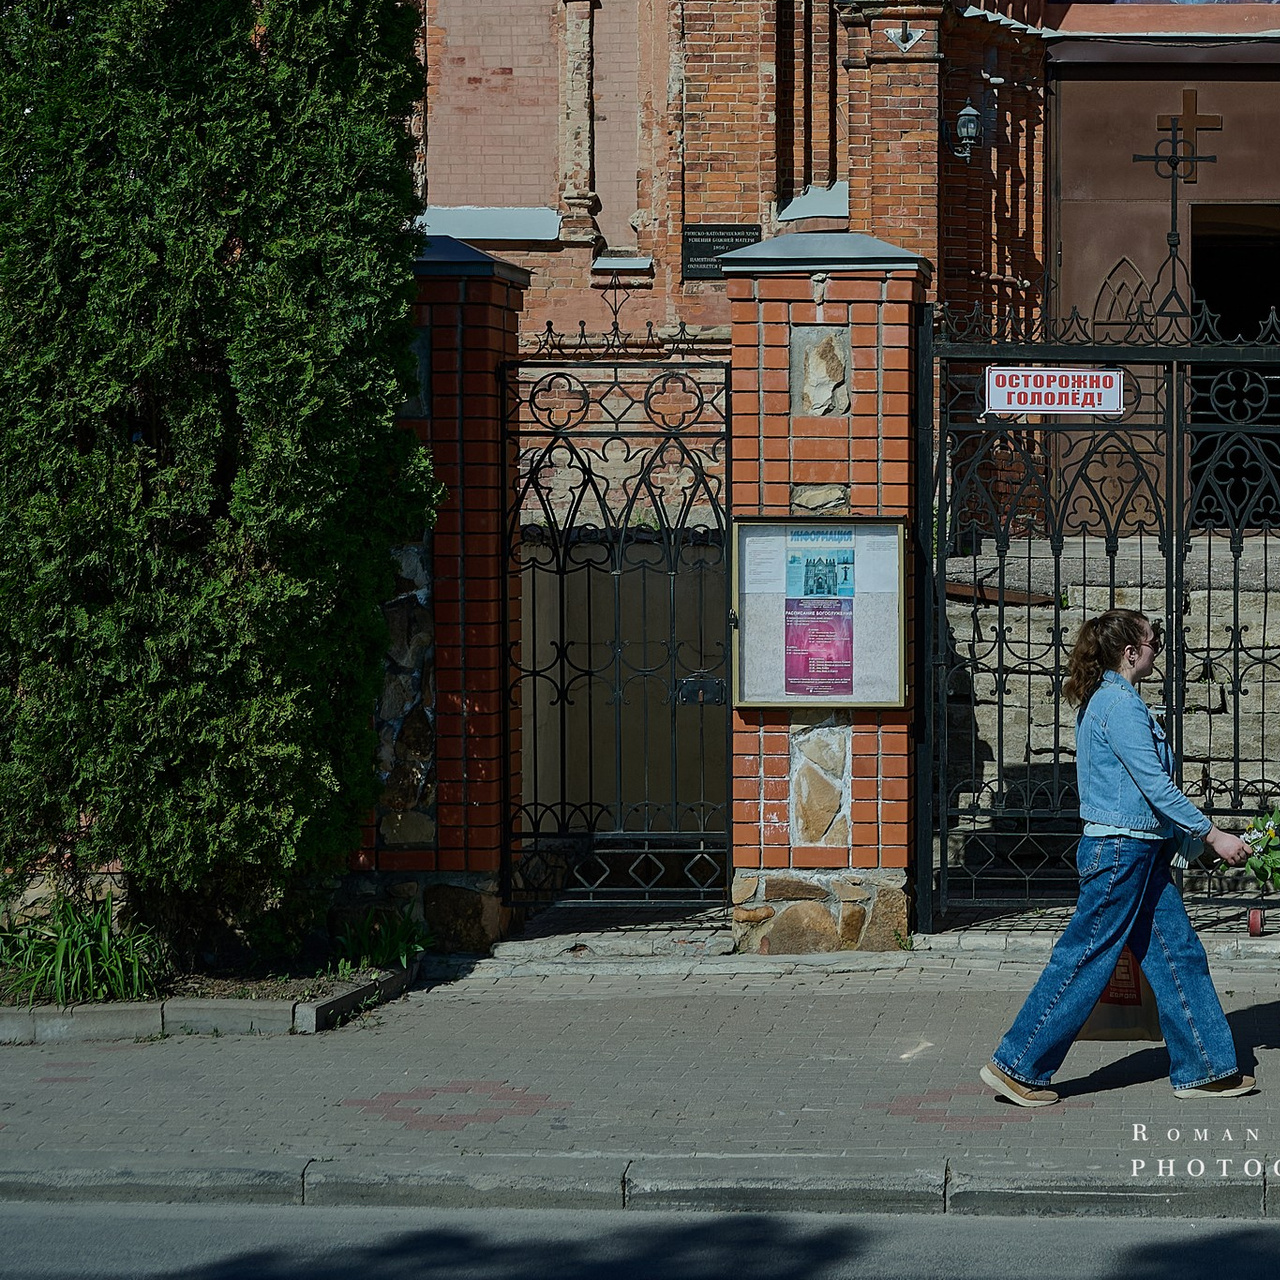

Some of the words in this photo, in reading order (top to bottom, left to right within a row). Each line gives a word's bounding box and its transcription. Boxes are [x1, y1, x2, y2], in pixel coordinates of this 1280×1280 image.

[995, 374, 1114, 389] ОСТОРОЖНО
[1007, 390, 1103, 408] ГОЛОЛЁД!
[790, 530, 852, 543] ИНФОРМАЦИЯ
